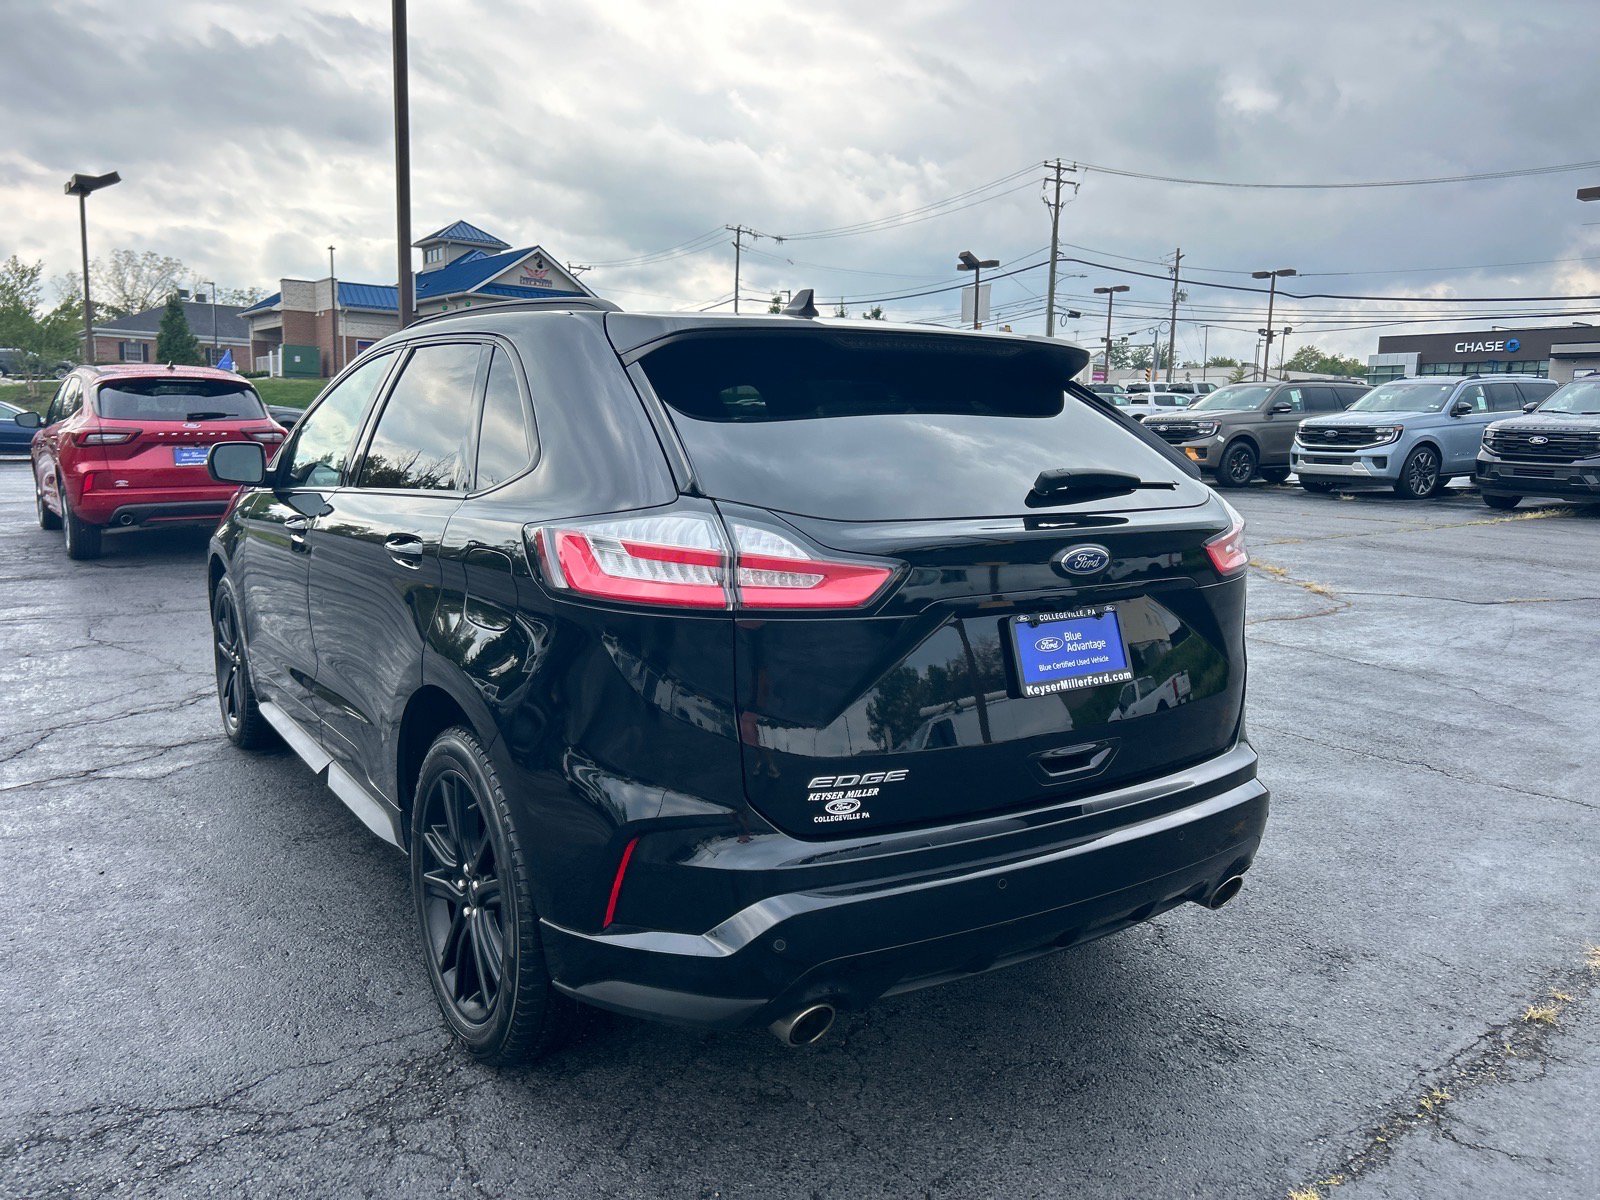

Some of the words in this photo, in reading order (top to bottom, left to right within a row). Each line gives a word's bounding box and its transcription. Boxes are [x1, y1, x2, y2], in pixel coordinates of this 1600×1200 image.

[1455, 340, 1504, 353] CHASE
[1074, 553, 1100, 569] Ford
[1039, 610, 1086, 621] COLLEGEVILLE,
[1064, 631, 1082, 642] Blue
[1040, 639, 1059, 650] Ford
[1066, 639, 1107, 653] Advantage
[1038, 663, 1052, 672] Blue
[1052, 660, 1076, 670] Certified
[1076, 657, 1090, 666] Used
[1090, 655, 1109, 664] Vehicle
[1026, 671, 1132, 696] KeyserMillerFord.com
[807, 769, 910, 789] EDGE
[807, 791, 844, 801] KEYSER
[845, 787, 880, 799] MILLER
[813, 812, 860, 823] COLLEGEVILLE
